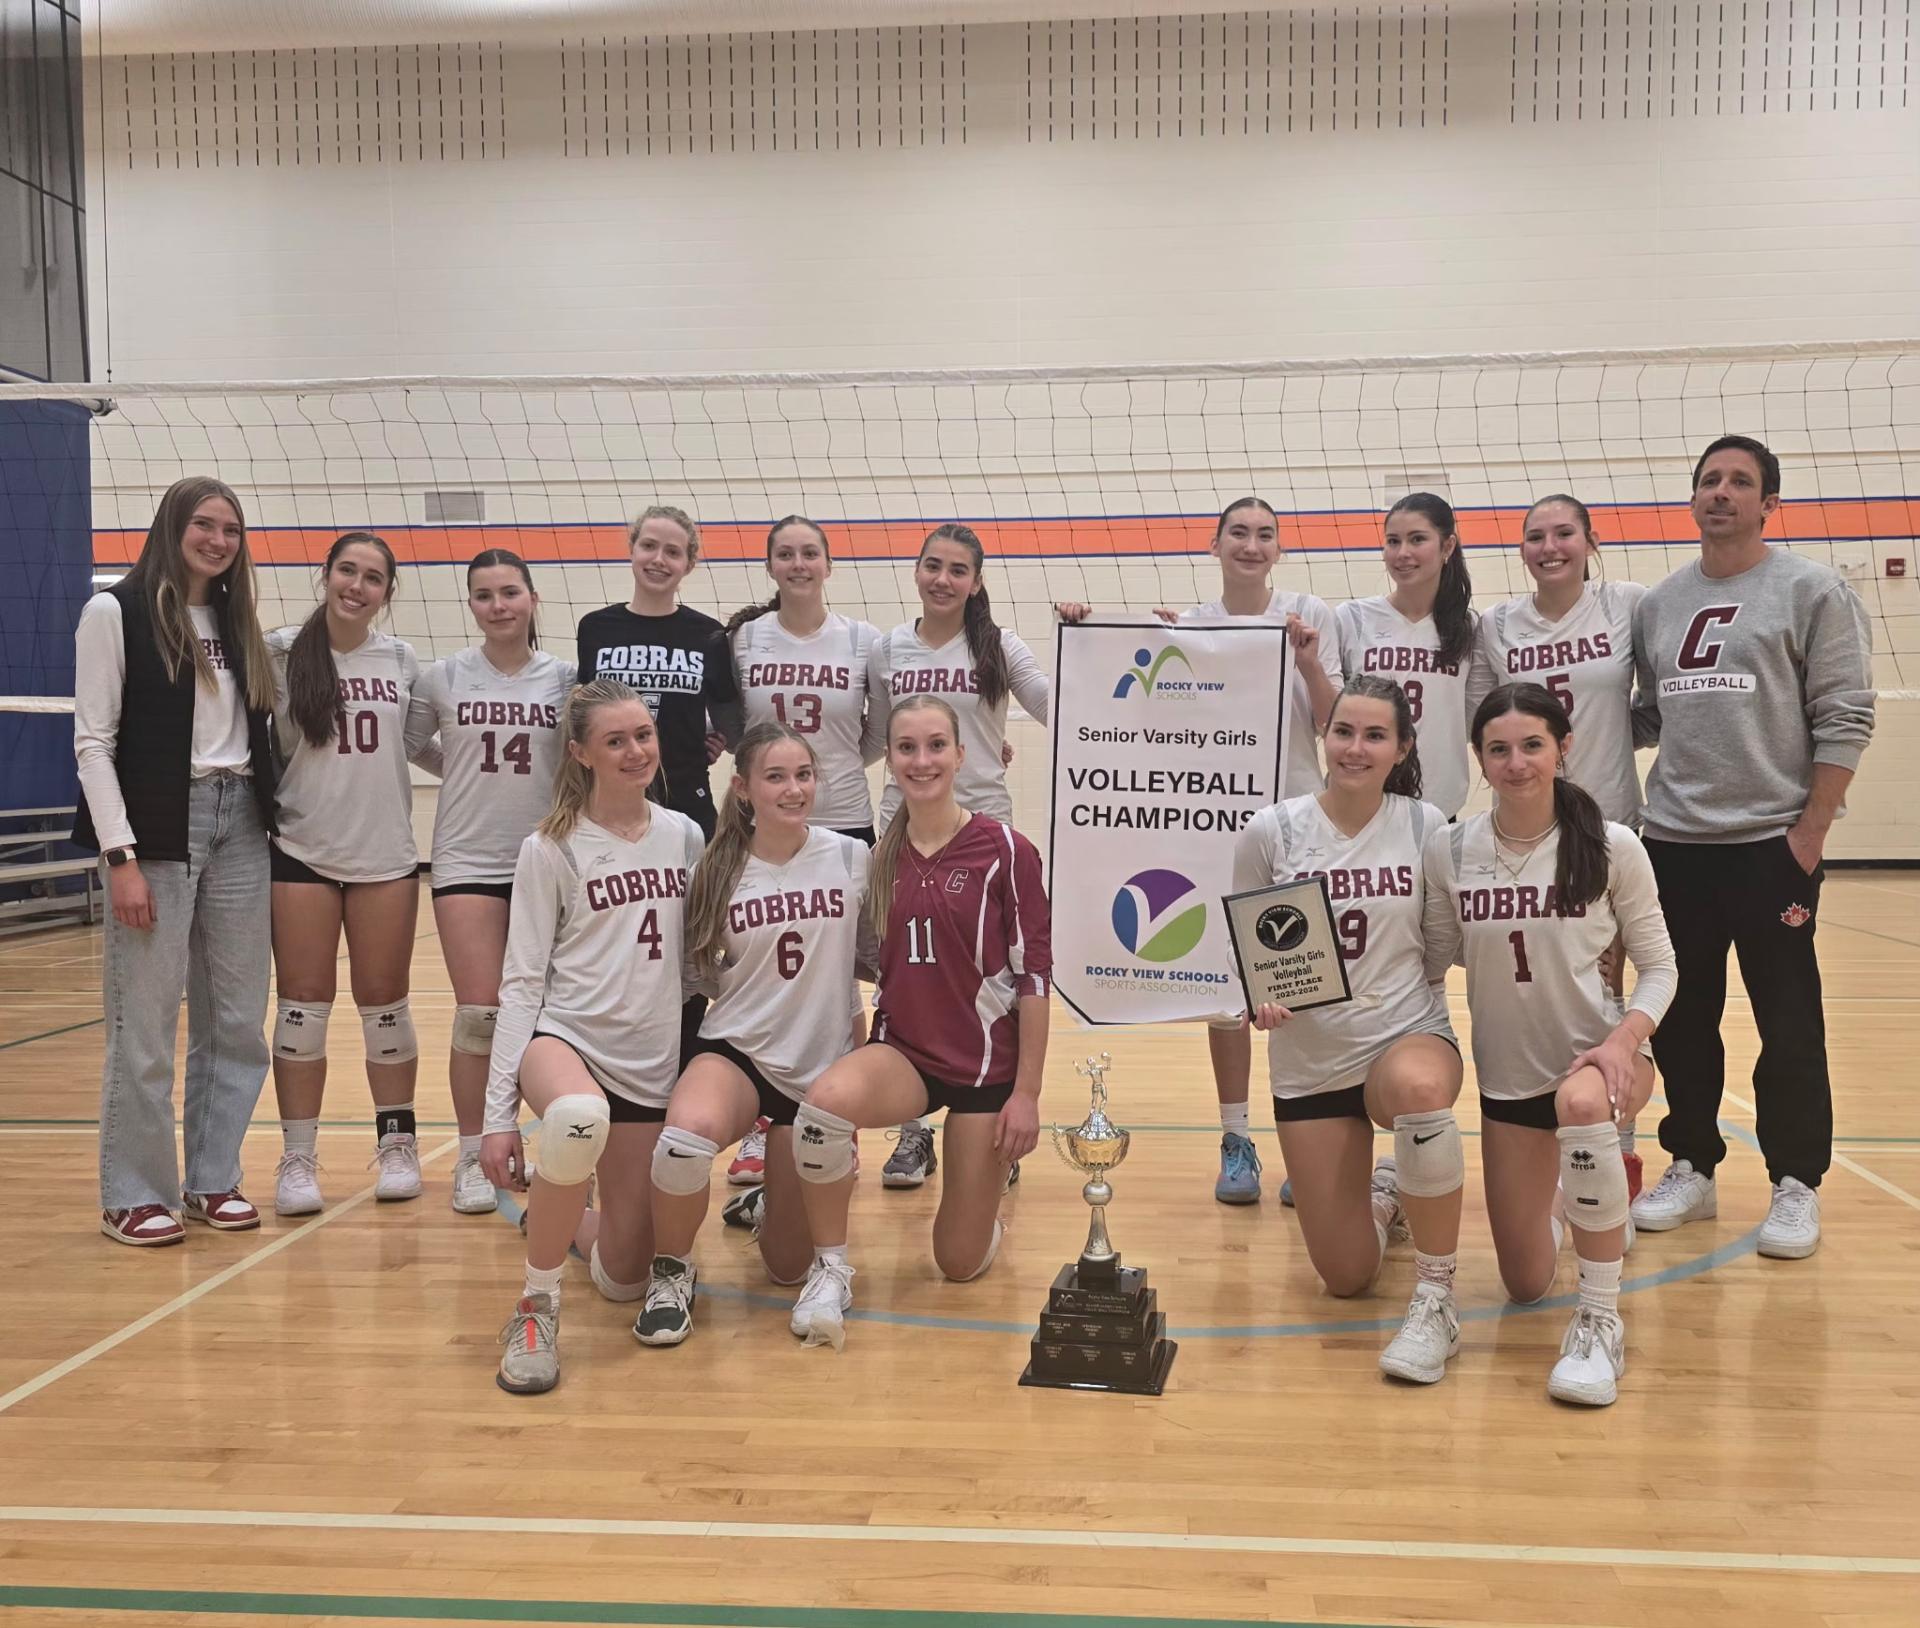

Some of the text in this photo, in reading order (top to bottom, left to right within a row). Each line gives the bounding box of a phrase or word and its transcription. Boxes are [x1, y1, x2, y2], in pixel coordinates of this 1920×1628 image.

[596, 645, 704, 675] COBRAS
[1507, 632, 1612, 674] COBRAS
[337, 677, 399, 704] BRAS
[749, 663, 850, 690] COBRAS
[891, 668, 982, 696] COBRAS
[1156, 681, 1225, 692] ROCKY VIEW
[1662, 677, 1748, 693] VOLLEYBALL
[1156, 691, 1197, 701] SCHOOLS
[1546, 673, 1575, 718] 5
[457, 701, 558, 729] COBRAS
[771, 692, 823, 734] 13
[335, 710, 379, 755] 10
[1078, 726, 1257, 749] Senior Varsity Girls
[480, 730, 532, 775] 14
[1067, 768, 1264, 796] VOLLEYBALL
[586, 867, 687, 912] COBRAS
[729, 888, 844, 935] COBRAS
[637, 908, 663, 960] 4
[905, 915, 937, 965] 11
[1339, 909, 1368, 960] 9
[776, 930, 805, 981] 6
[1254, 949, 1325, 972] Senior Varsity Girls
[1508, 930, 1532, 983] 1
[1085, 965, 1229, 984] ROCKY VIEW SCHOOLS
[1267, 976, 1323, 993] FIRST PLACE
[1272, 964, 1313, 980] Volleyball
[1094, 978, 1218, 996] SPORTS ASSOCIATION
[1275, 985, 1319, 999] 2025-2026
